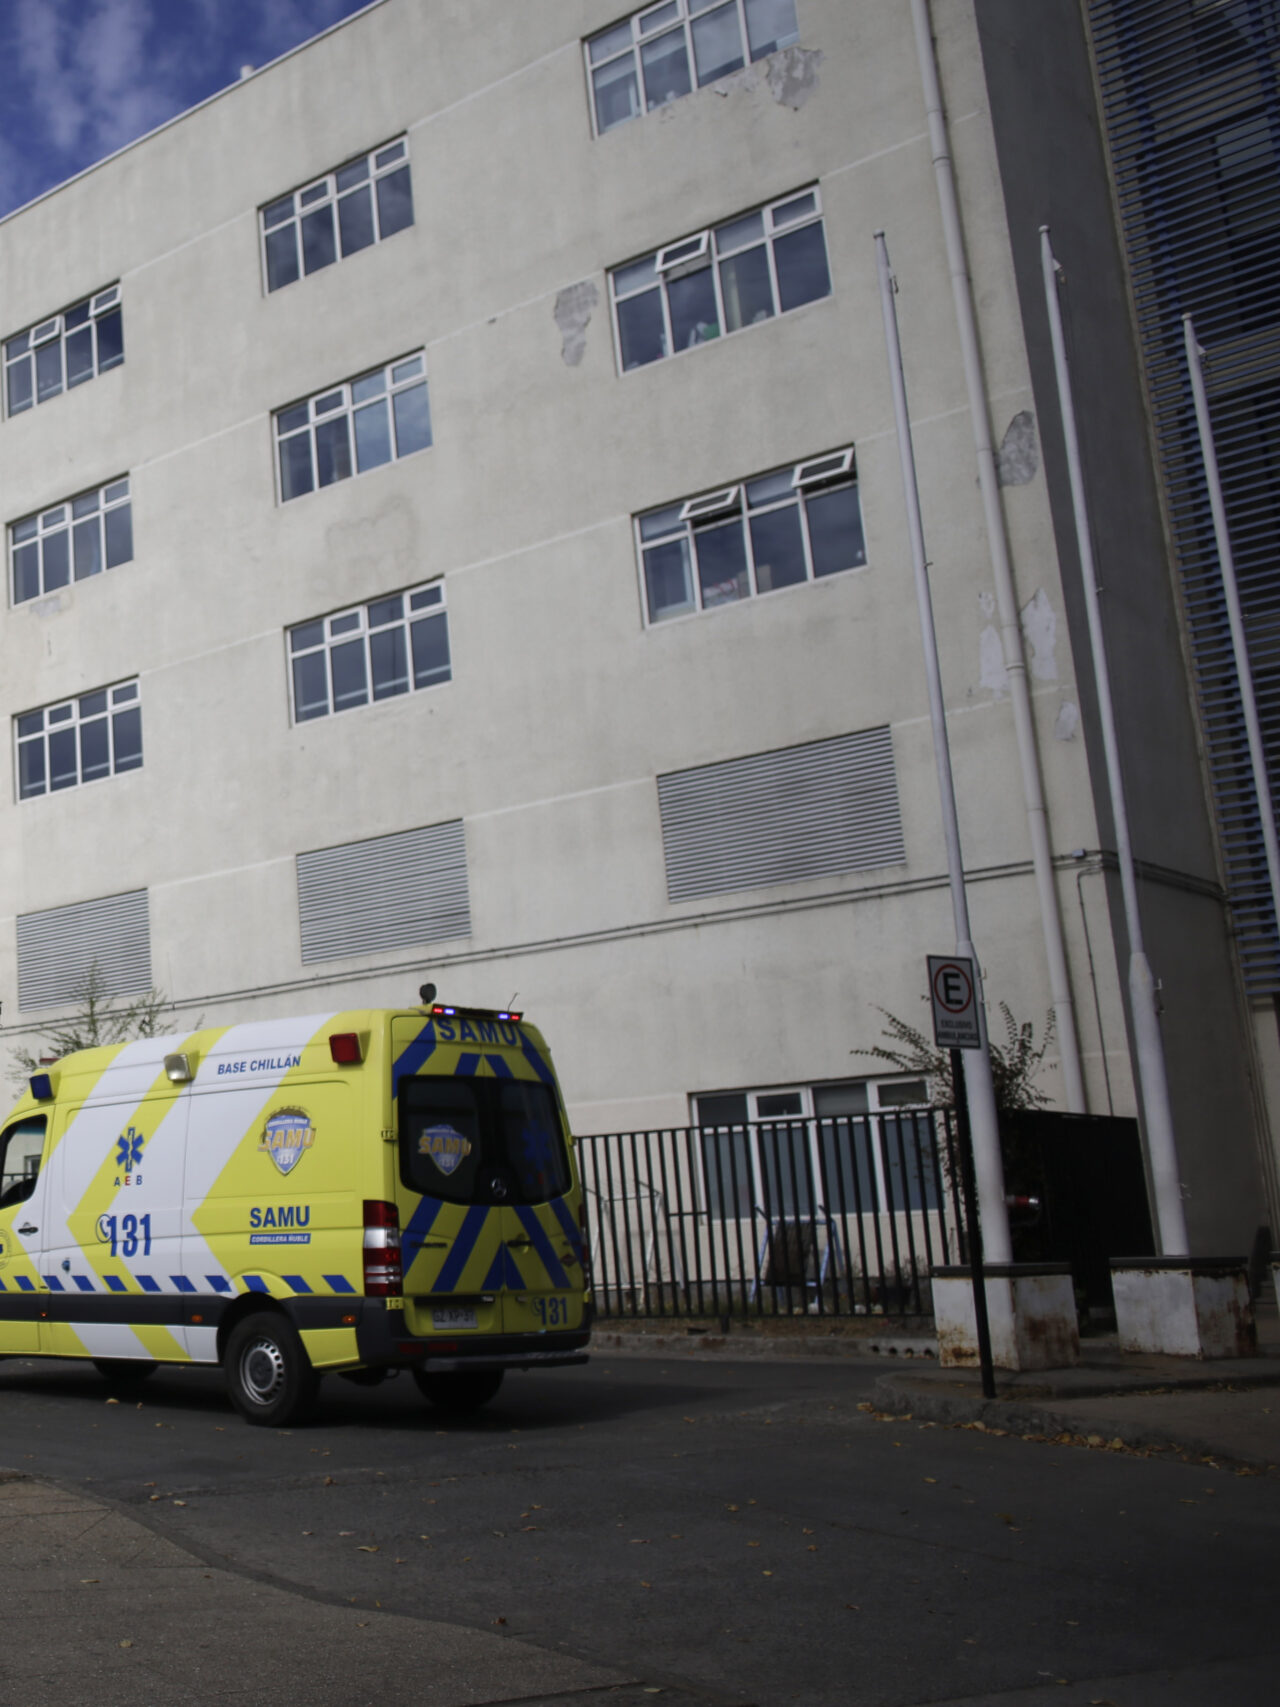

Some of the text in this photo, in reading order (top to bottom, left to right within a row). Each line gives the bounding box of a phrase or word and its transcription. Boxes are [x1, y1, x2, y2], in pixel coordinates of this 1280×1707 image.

[943, 972, 963, 1005] E
[437, 1017, 518, 1046] SAMU
[217, 1055, 301, 1075] BASE CHILLÁN
[257, 1128, 317, 1152] SAMU
[418, 1136, 472, 1157] SAMU
[249, 1205, 310, 1229] SAMU
[106, 1213, 151, 1258] 131
[539, 1296, 568, 1326] 131
